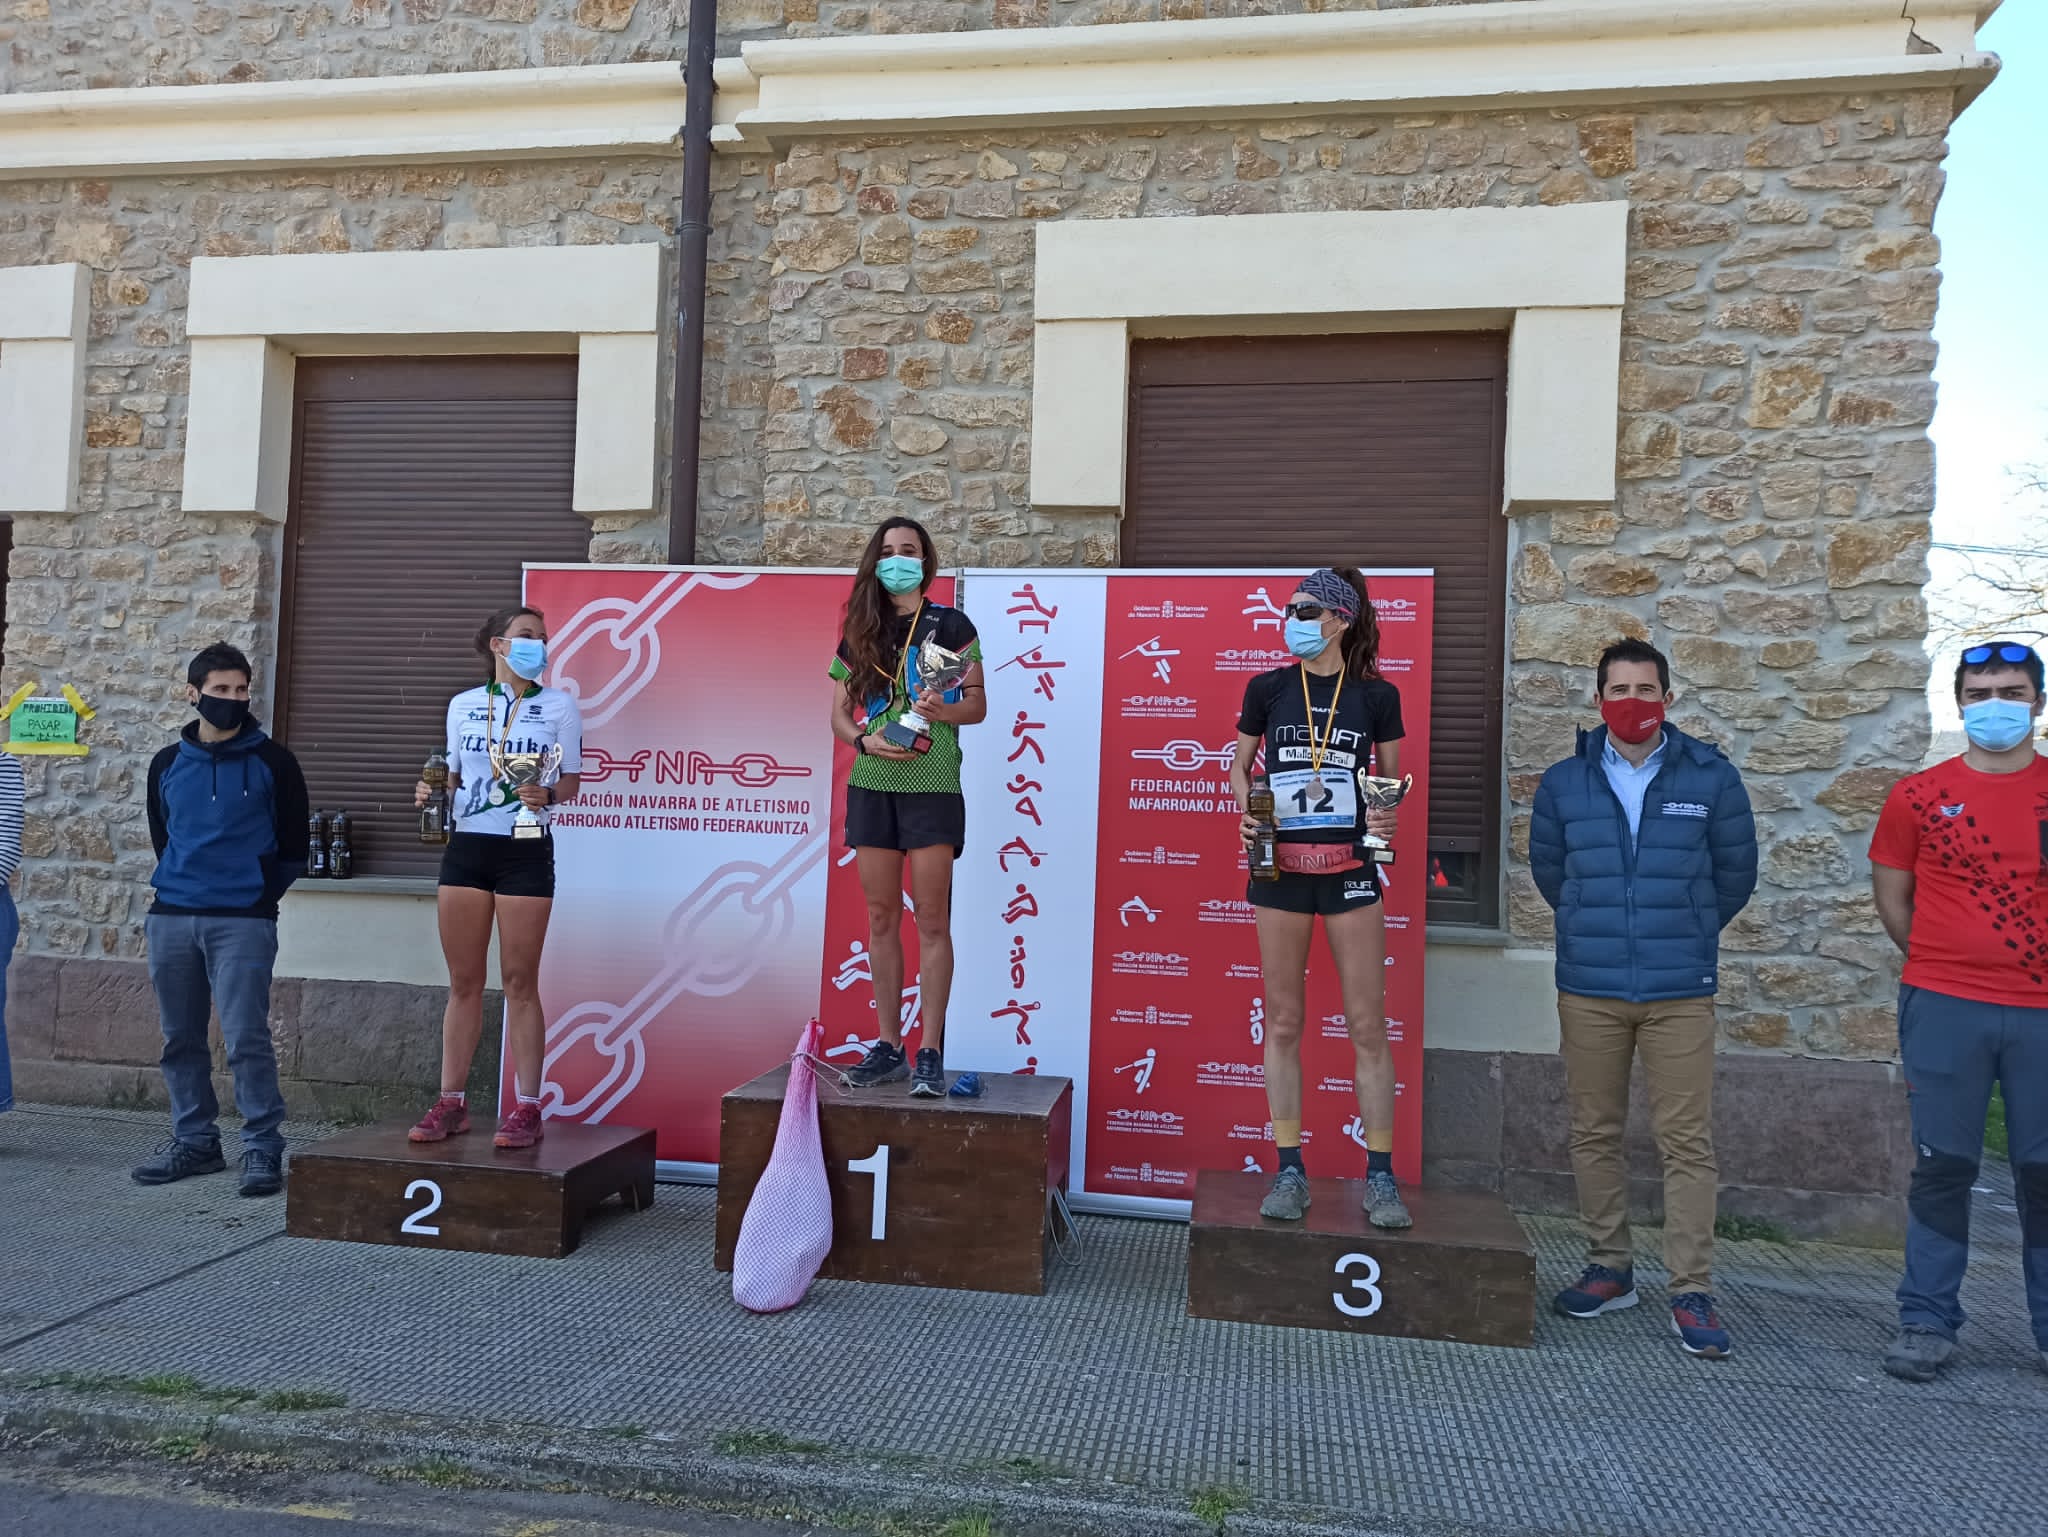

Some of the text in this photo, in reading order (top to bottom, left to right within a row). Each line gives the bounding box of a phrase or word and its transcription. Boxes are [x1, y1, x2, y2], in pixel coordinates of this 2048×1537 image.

[28, 719, 61, 730] PASAR
[1130, 778, 1215, 793] FEDERACIÓN
[629, 795, 697, 810] NAVARRA
[702, 797, 720, 811] DE
[725, 798, 810, 814] ATLETISMO
[1129, 797, 1214, 812] NAFARROAKO
[1291, 787, 1334, 813] 12
[624, 815, 699, 831] ATLETISMO
[703, 818, 809, 835] FEDERAKUNTZA
[847, 1144, 889, 1240] 1
[401, 1179, 442, 1236] 2
[1333, 1252, 1383, 1317] 3
